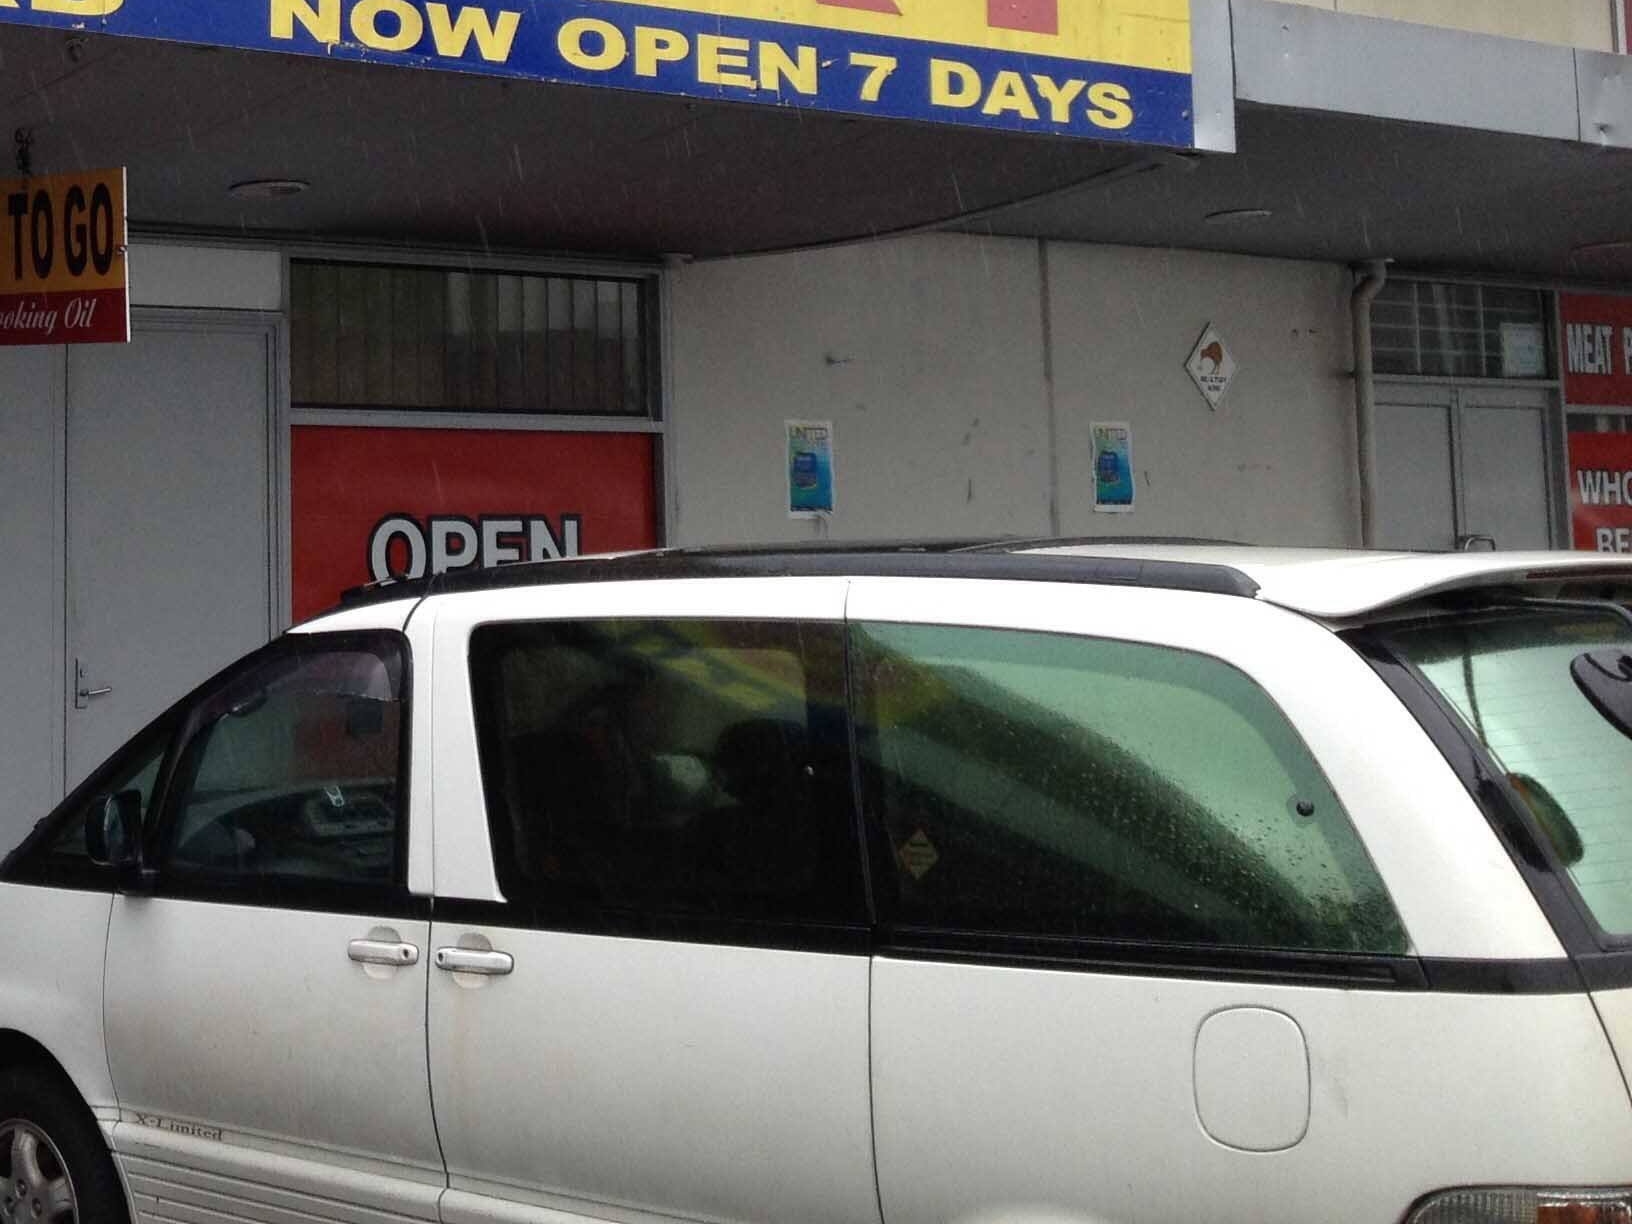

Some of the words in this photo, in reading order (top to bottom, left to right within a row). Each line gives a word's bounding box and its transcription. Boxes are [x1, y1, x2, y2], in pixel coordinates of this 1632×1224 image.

[556, 19, 818, 96] OPEN
[848, 52, 890, 104] 7
[930, 59, 1135, 132] DAYS
[7, 189, 55, 281] TO
[63, 182, 115, 277] GO
[64, 296, 98, 329] Oil
[1567, 324, 1614, 375] MEAT
[369, 516, 579, 583] OPEN
